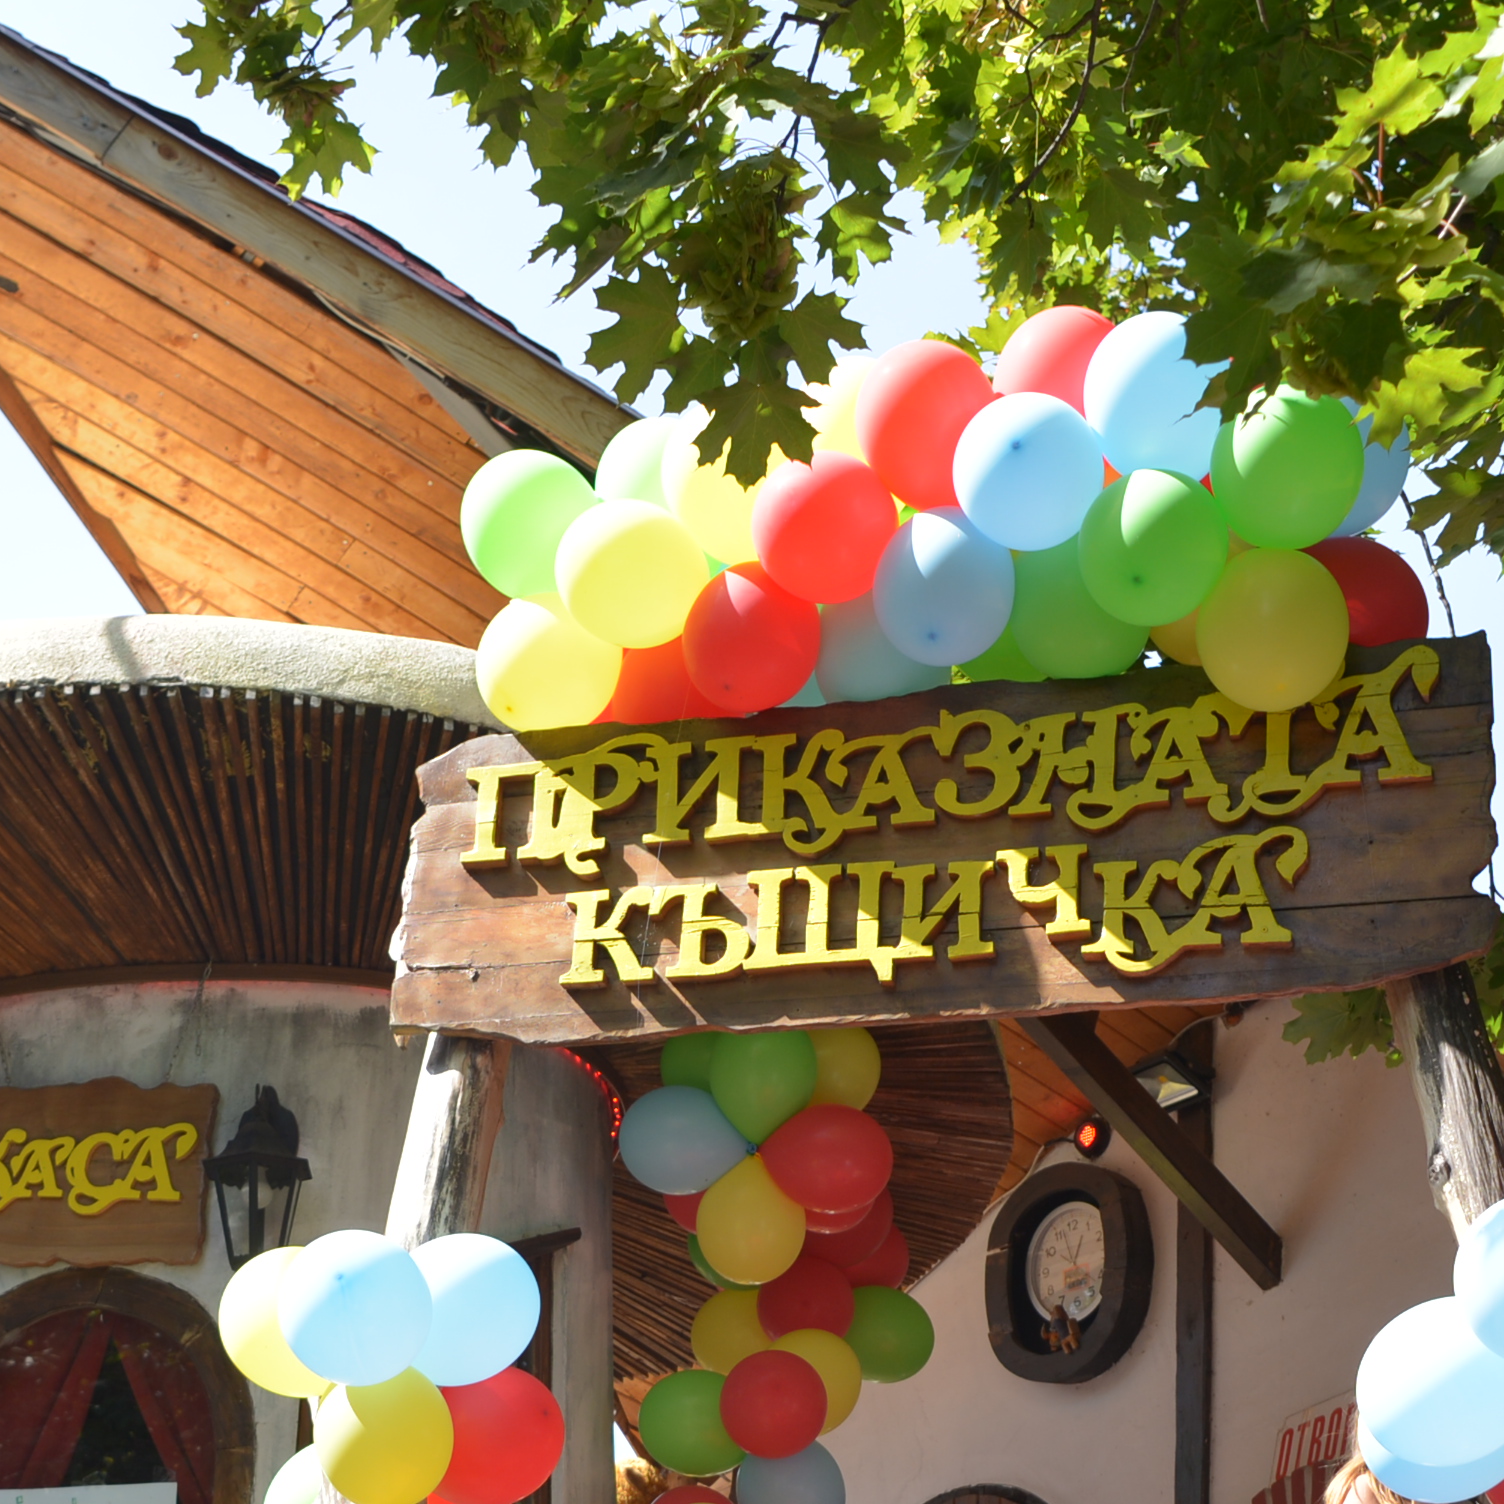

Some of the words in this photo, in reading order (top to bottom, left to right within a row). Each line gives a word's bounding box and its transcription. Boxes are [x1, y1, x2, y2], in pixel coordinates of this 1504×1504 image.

[460, 645, 1441, 879] ПРИКАЗНАТА
[560, 825, 1310, 988] КЪЩИЧКА
[1067, 1219, 1078, 1231] 12
[1086, 1221, 1090, 1231] 1
[1055, 1230, 1062, 1241] 11
[1096, 1231, 1102, 1241] 2
[1045, 1246, 1056, 1258] 10
[1042, 1268, 1050, 1278] 9
[1047, 1285, 1054, 1295] 8
[1088, 1286, 1095, 1297] 5
[1059, 1295, 1065, 1305] 7
[1073, 1296, 1081, 1307] 6
